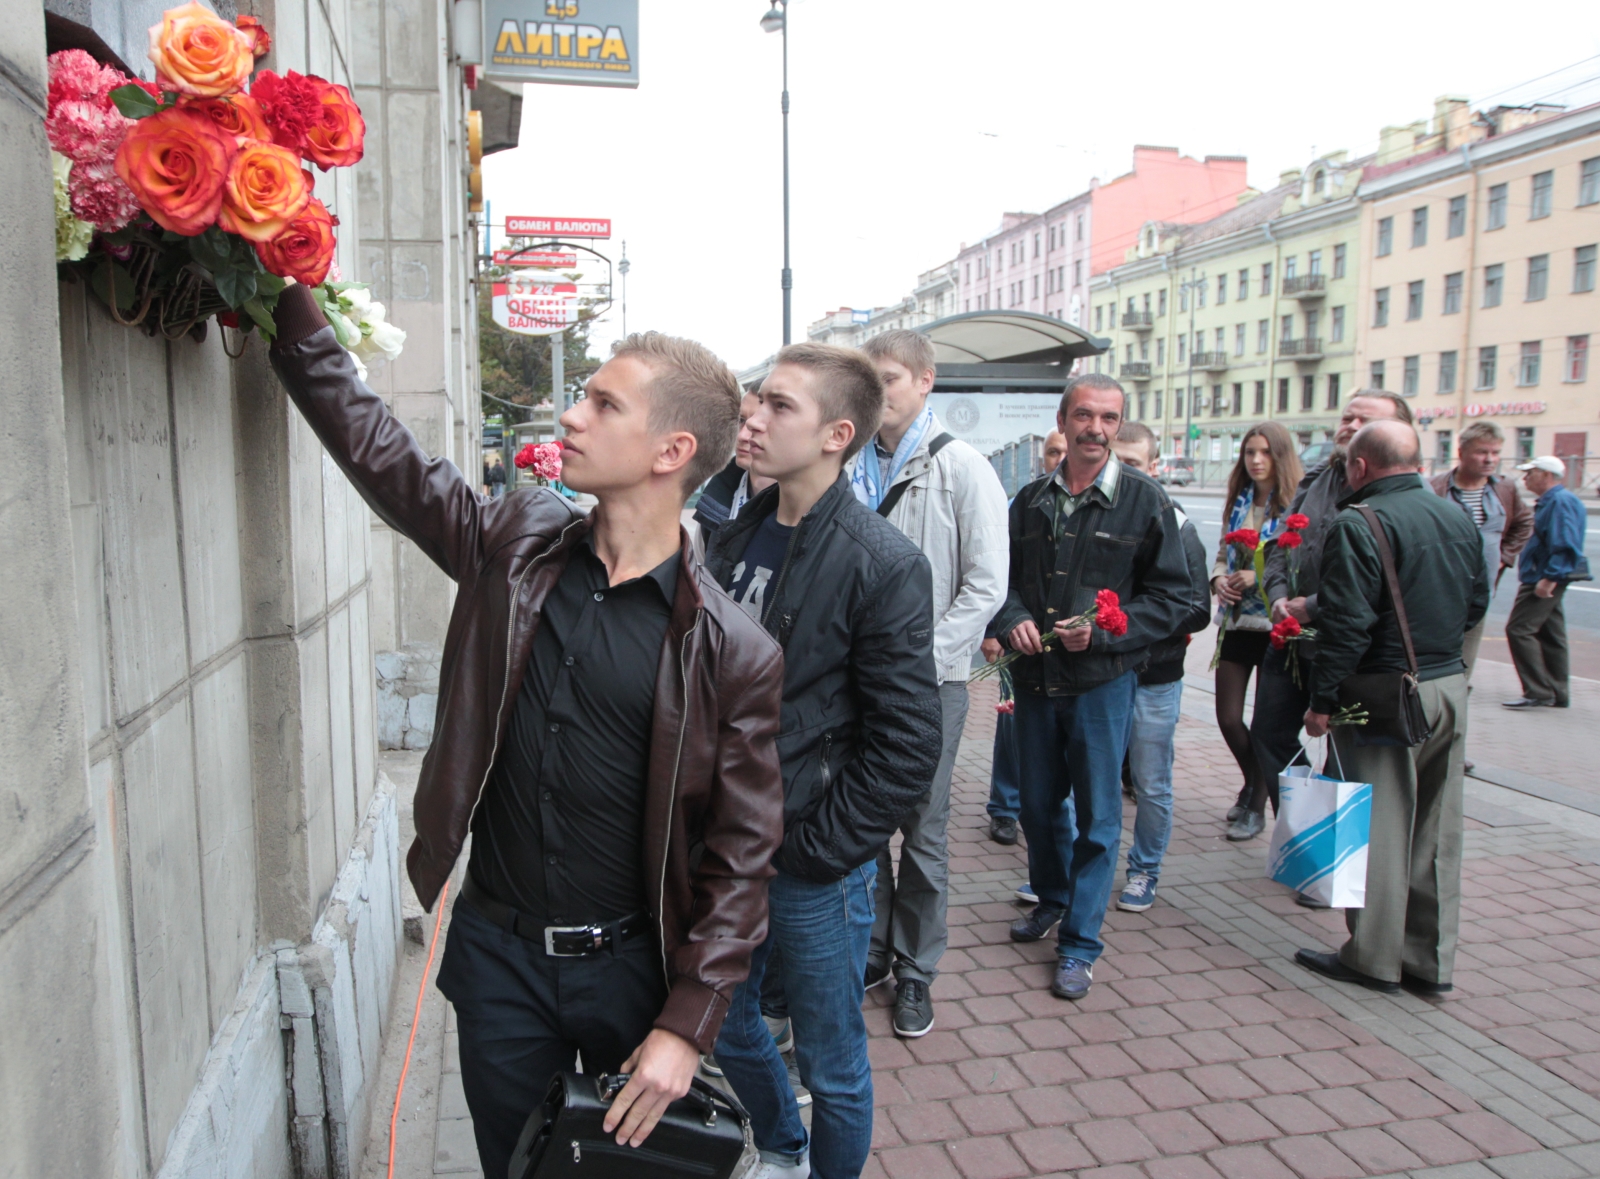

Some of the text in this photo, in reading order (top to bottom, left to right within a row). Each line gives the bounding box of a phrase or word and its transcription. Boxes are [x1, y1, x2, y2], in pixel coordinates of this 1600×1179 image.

[495, 20, 628, 60] ЛИТРА
[508, 219, 608, 232] ОБМЕН ВАЛЮТЫ
[508, 299, 567, 315] ОБМЕН
[508, 316, 567, 328] ВАЛЮТЫ
